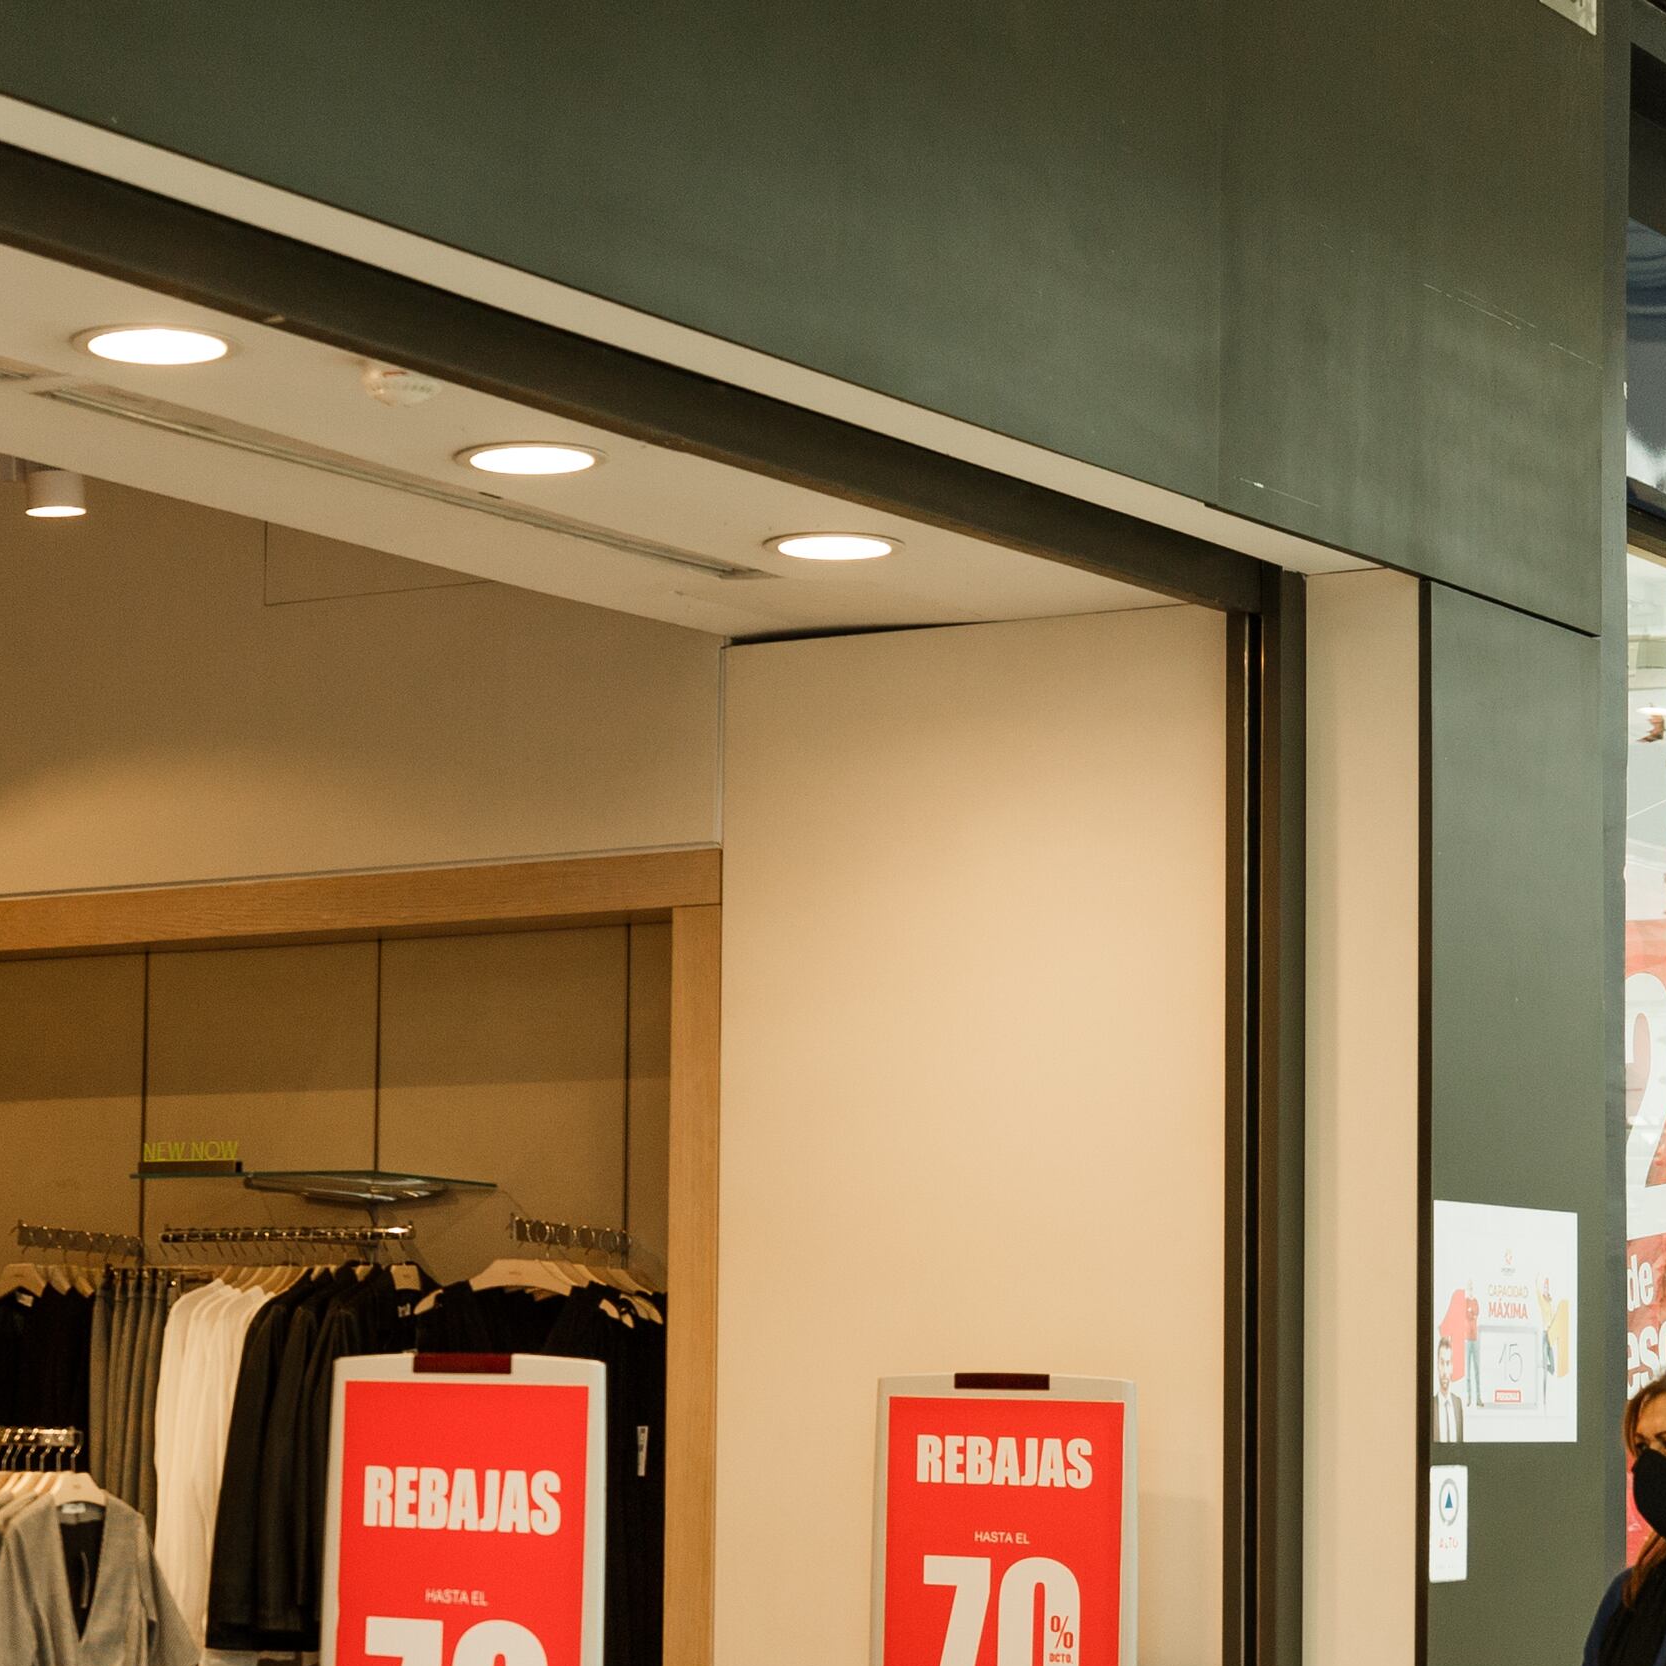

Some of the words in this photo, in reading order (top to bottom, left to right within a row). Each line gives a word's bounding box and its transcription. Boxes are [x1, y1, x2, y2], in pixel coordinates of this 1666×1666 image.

[144, 1141, 185, 1161] NEW
[191, 1140, 238, 1161] NOW
[1488, 1297, 1529, 1320] MÁXIMA
[1498, 1343, 1524, 1382] 15
[916, 1434, 1093, 1490] REBAJAS
[363, 1465, 562, 1537] REBAJAS
[974, 1531, 1013, 1544] HASTA
[1015, 1532, 1030, 1545] EL
[424, 1588, 468, 1605] HASTA
[471, 1590, 488, 1607] EL
